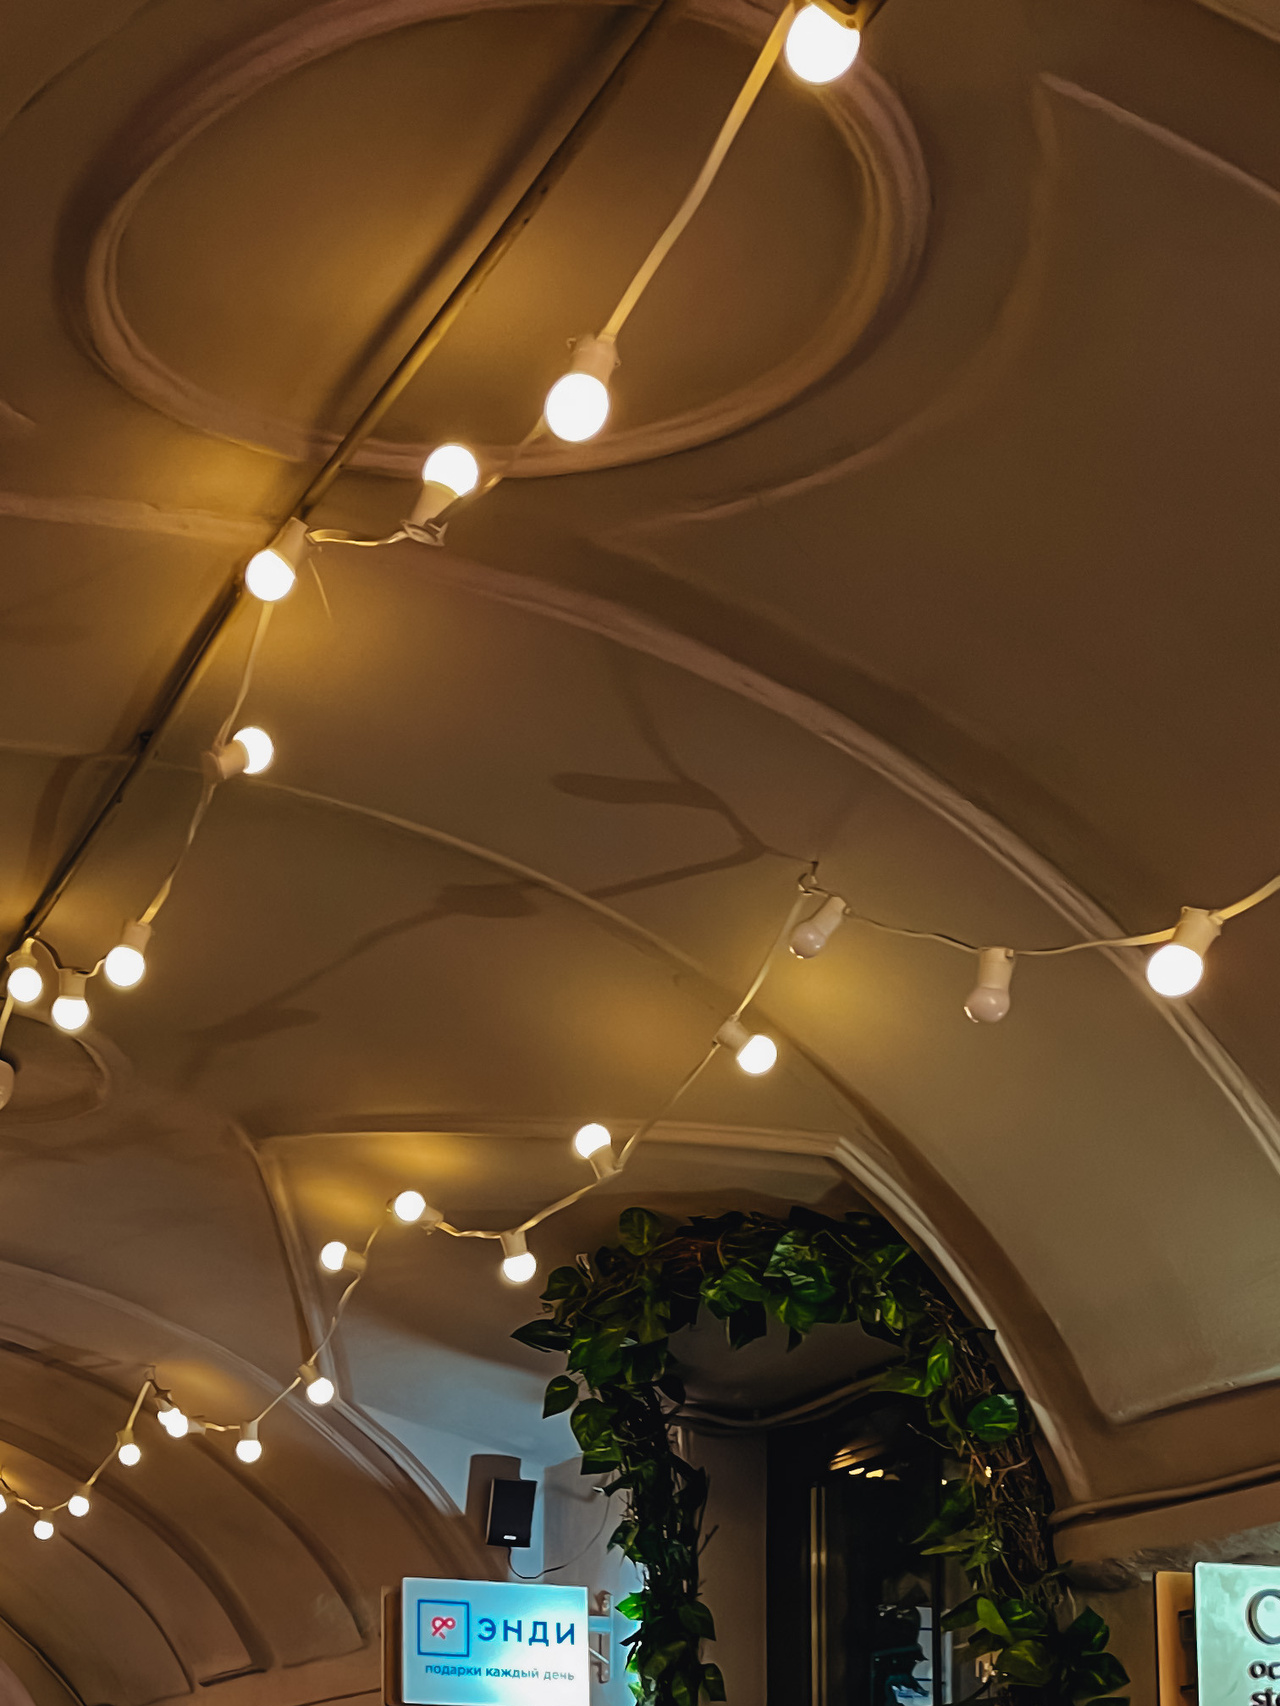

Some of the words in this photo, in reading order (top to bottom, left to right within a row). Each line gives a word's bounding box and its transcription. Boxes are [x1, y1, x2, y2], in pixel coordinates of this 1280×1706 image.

[477, 1617, 575, 1647] ЭНДИ
[425, 1664, 482, 1677] подарки
[485, 1667, 539, 1679] каждый
[543, 1670, 575, 1681] день
